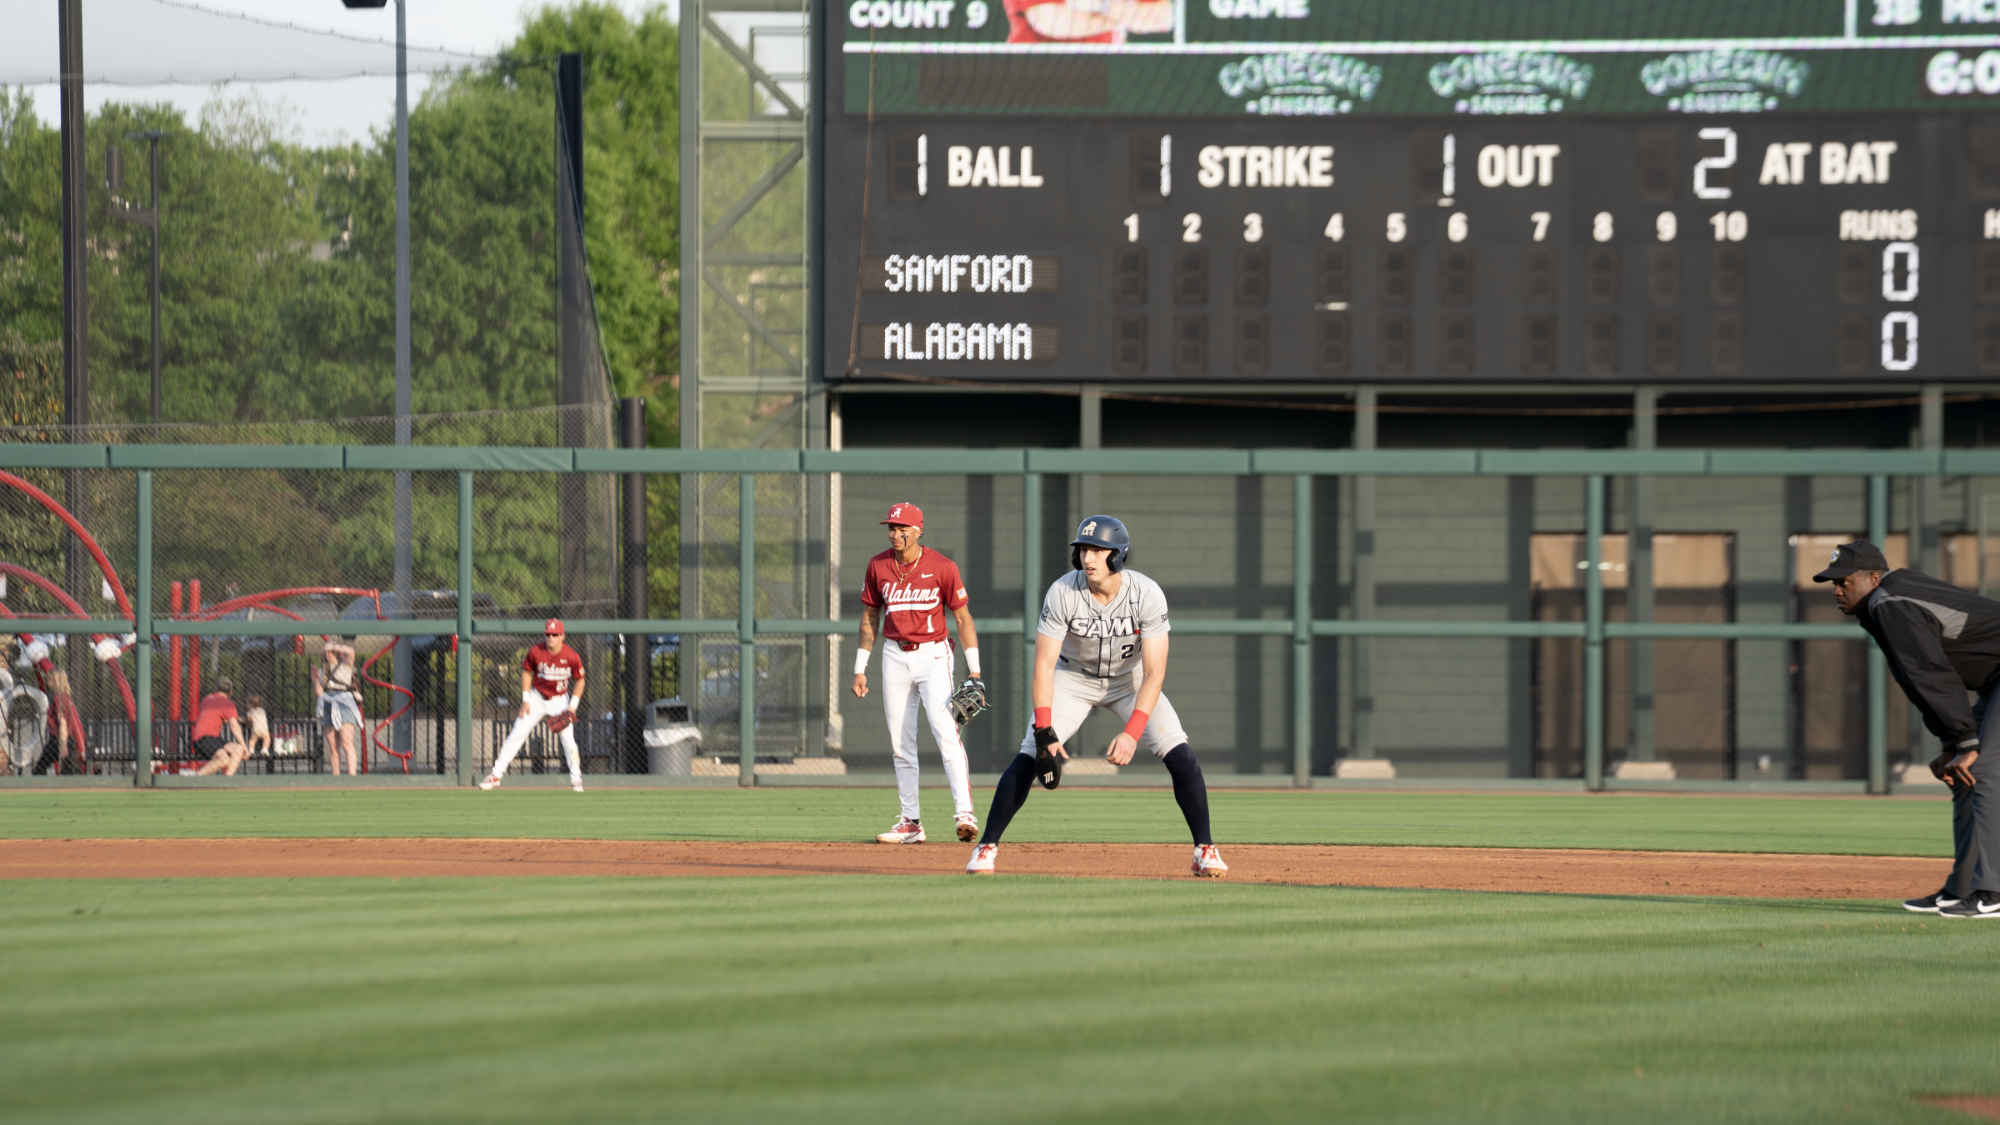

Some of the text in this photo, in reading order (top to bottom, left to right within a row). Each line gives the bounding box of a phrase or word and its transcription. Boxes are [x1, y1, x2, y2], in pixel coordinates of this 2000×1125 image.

[849, 0, 989, 29] COUNT 9
[1208, 0, 1309, 19] GAME
[948, 145, 1044, 188] BALL
[1198, 145, 1335, 188] STRIKE
[1478, 144, 1560, 187] OUT
[1693, 127, 1897, 199] 2 AT BAT
[1124, 213, 1139, 242] 1
[1183, 213, 1202, 242] 2
[1243, 212, 1263, 242] 3
[1324, 213, 1344, 241] 4
[1386, 212, 1406, 242] 5
[1447, 212, 1468, 242] 6
[1531, 211, 1551, 241] 7
[1593, 211, 1613, 242] 8
[1656, 211, 1677, 242] 9
[1710, 211, 1748, 241] 10
[1839, 209, 1918, 241] RUNS
[884, 241, 1919, 302] SAMFORD 0
[884, 311, 1919, 371] ALABAMA 0
[882, 582, 940, 604] Alabama
[927, 615, 934, 633] 1
